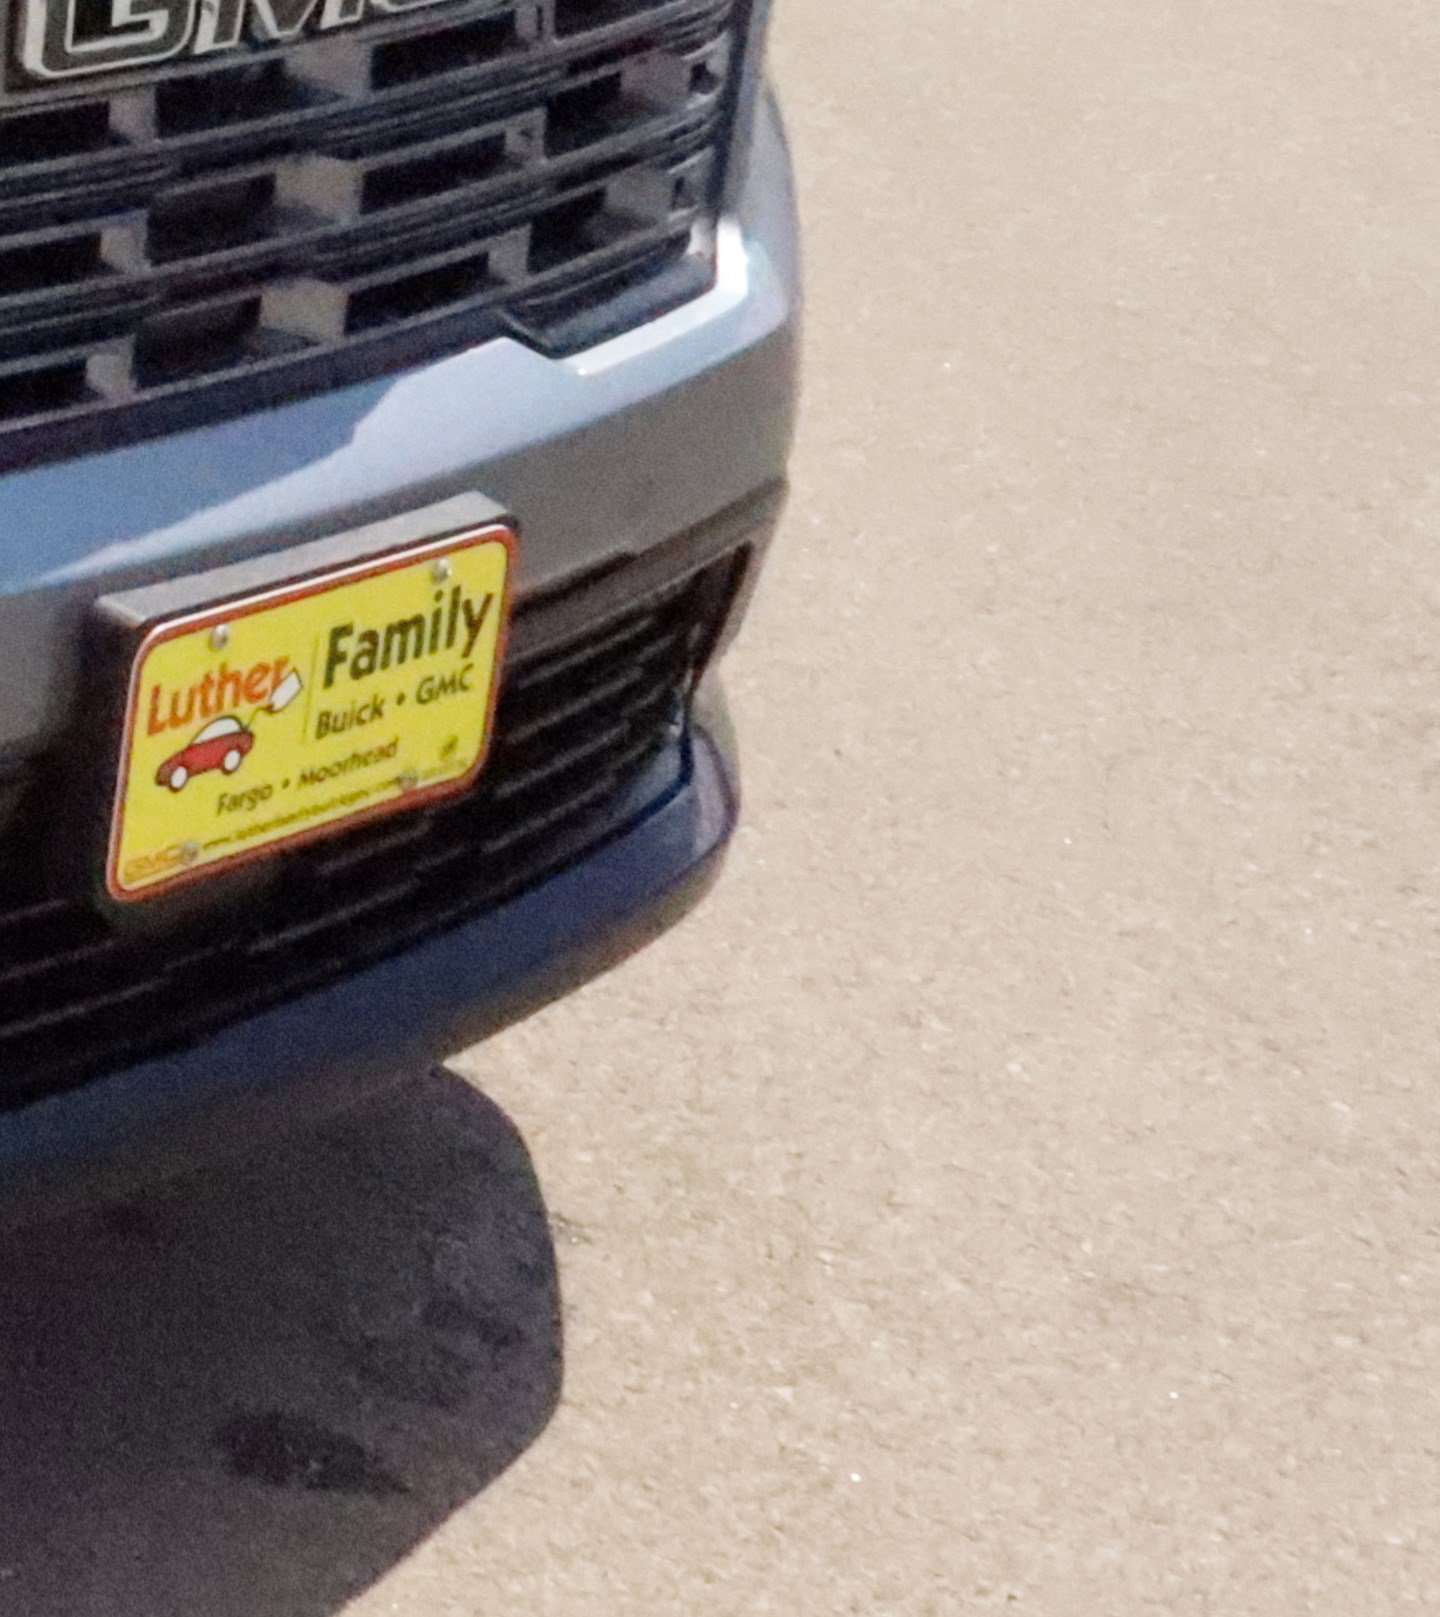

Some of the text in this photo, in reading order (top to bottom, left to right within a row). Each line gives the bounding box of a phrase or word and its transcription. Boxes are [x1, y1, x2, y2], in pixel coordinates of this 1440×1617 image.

[322, 584, 495, 690] Family
[146, 655, 289, 737] Luther
[314, 663, 476, 740] Buick GMC
[216, 784, 273, 816] Fargo
[296, 736, 400, 789] Moorhead
